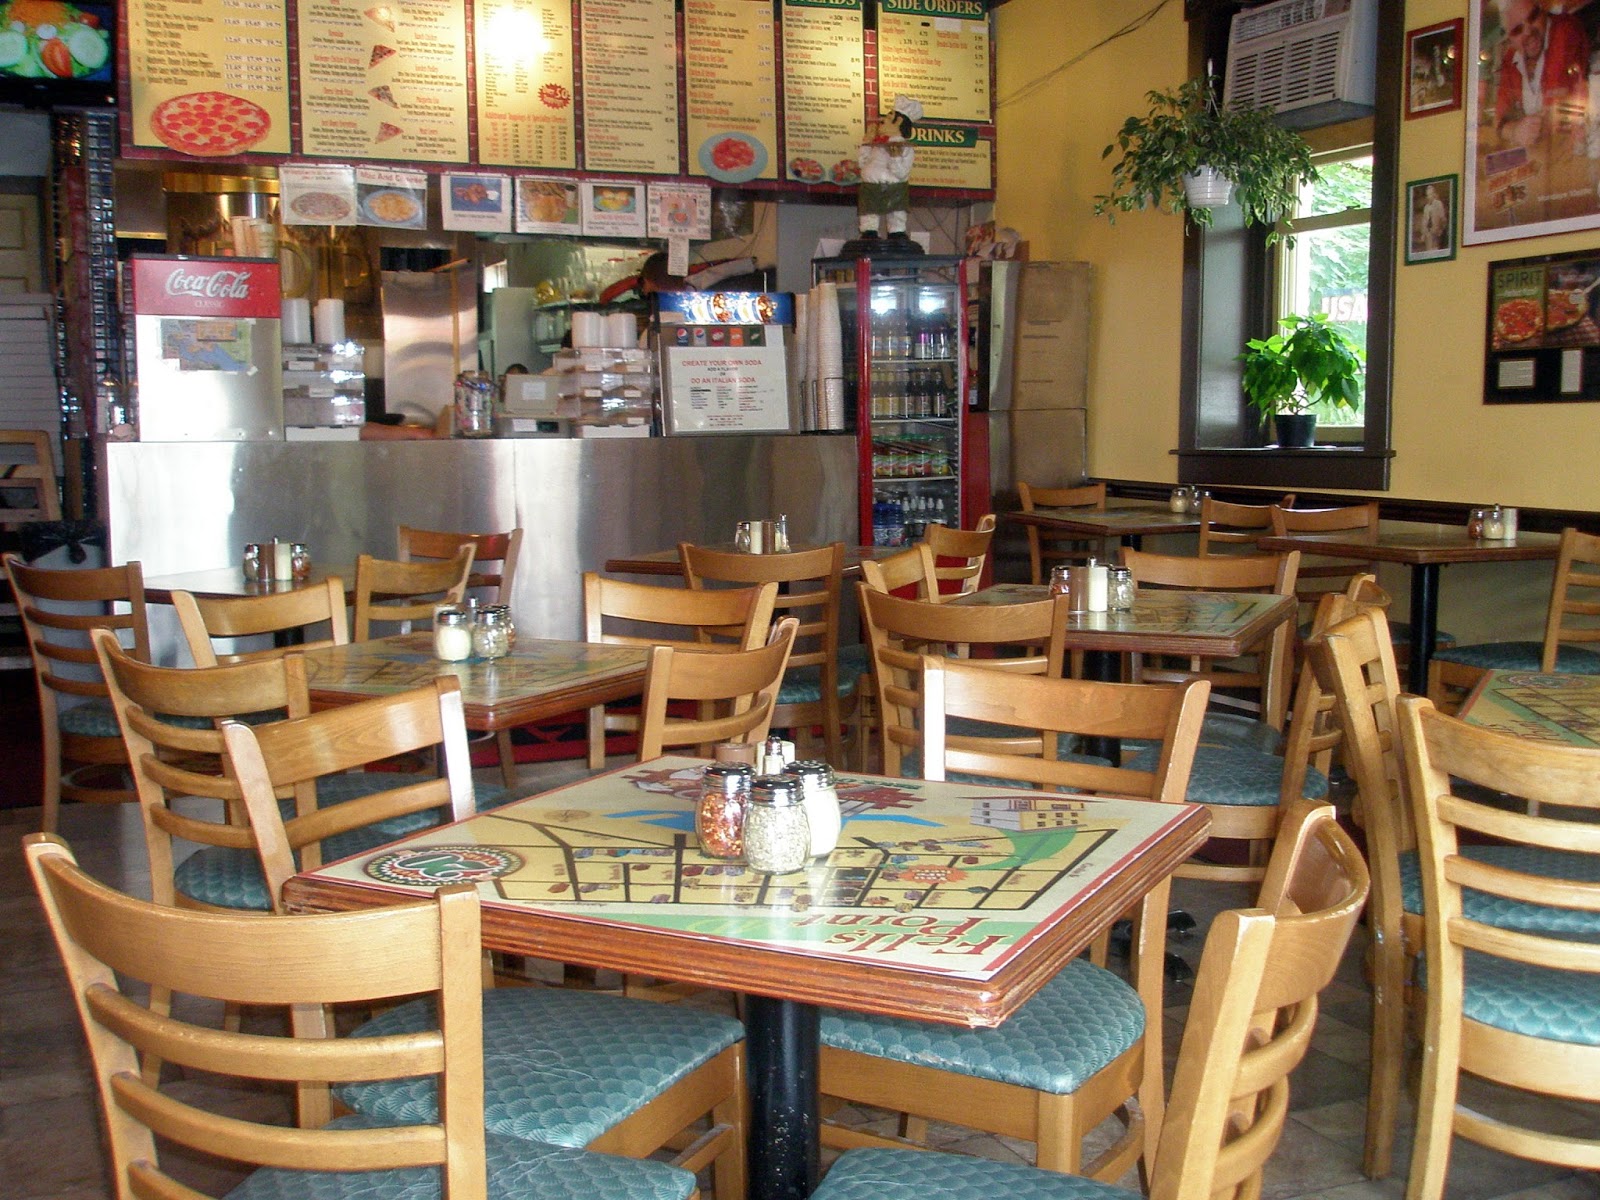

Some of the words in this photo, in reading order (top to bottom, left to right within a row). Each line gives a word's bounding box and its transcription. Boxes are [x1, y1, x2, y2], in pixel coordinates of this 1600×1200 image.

[887, 0, 921, 11] SIDE
[925, 0, 983, 15] ORDERS
[1497, 269, 1543, 288] SPIRIT
[793, 914, 990, 936] Point
[827, 932, 1010, 956] Fells
